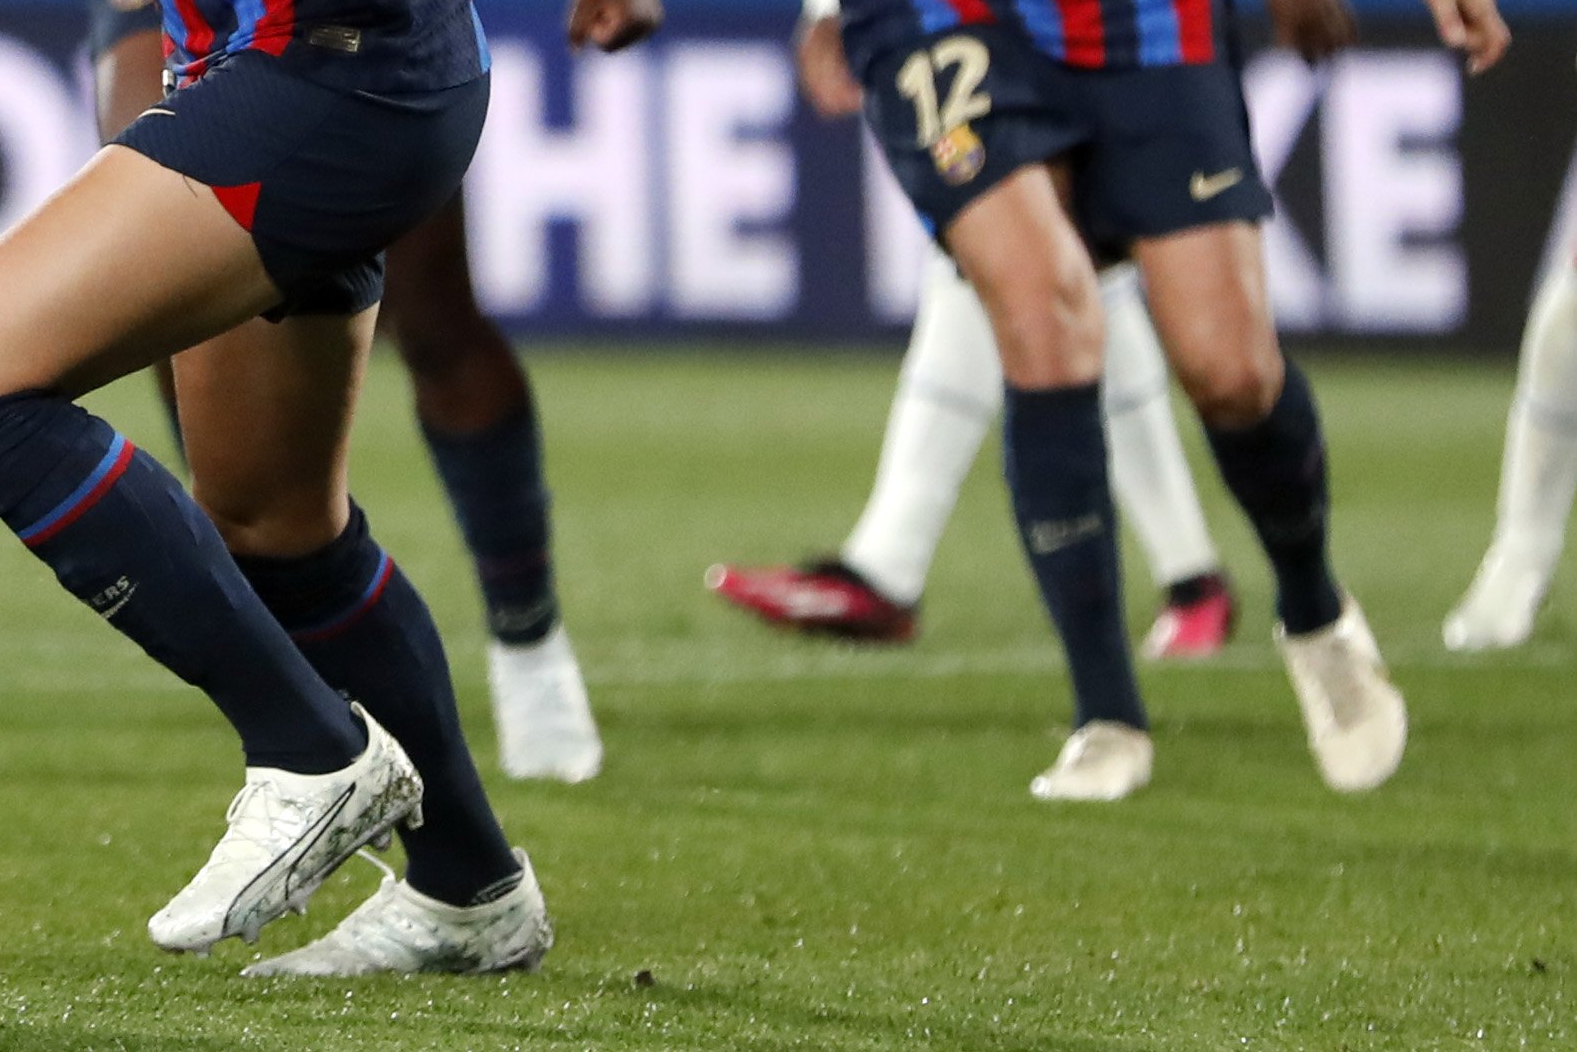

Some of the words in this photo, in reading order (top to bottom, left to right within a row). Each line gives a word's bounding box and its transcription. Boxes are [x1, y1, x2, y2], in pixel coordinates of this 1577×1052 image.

[896, 35, 992, 148] 12
[465, 38, 799, 322] HE
[92, 574, 130, 606] ERS
